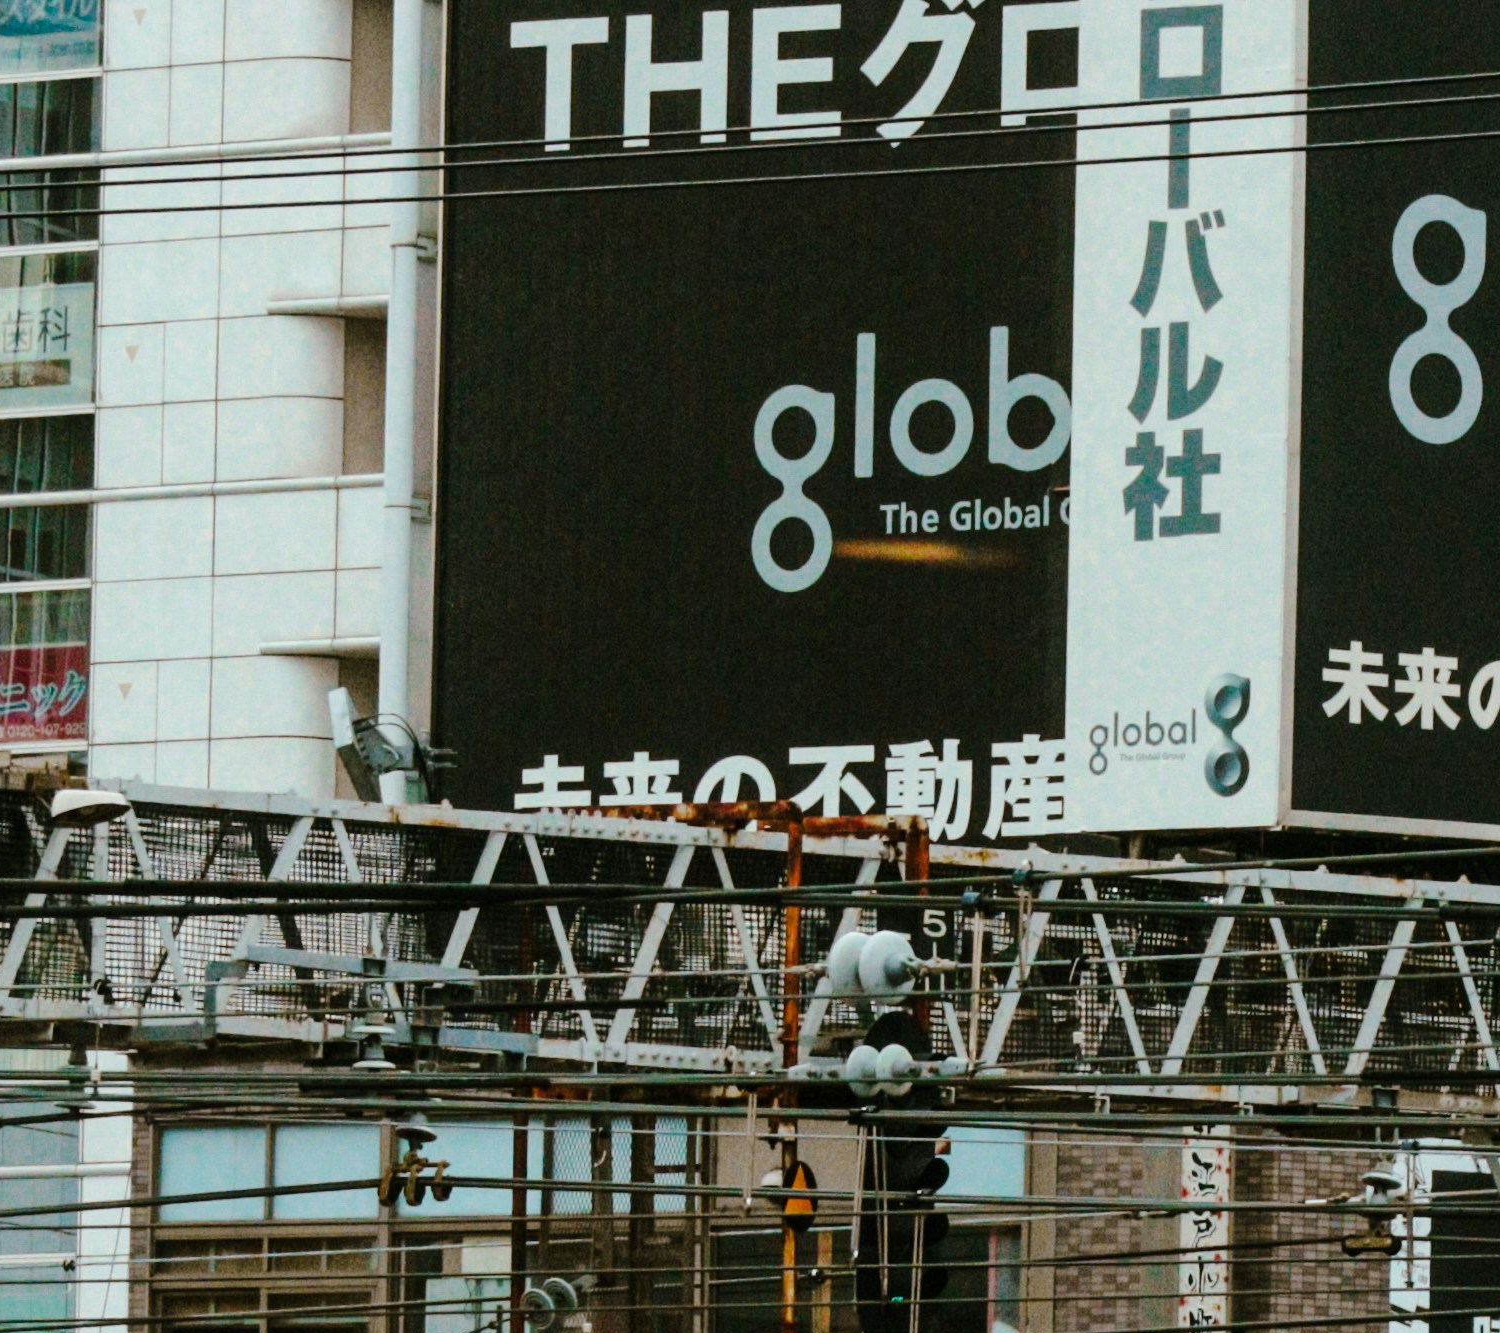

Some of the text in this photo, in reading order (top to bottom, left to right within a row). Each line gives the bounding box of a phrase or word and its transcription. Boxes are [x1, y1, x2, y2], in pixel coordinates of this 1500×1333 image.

[879, 502, 939, 536] The
[949, 497, 1051, 532] Global
[1088, 708, 1197, 776] global
